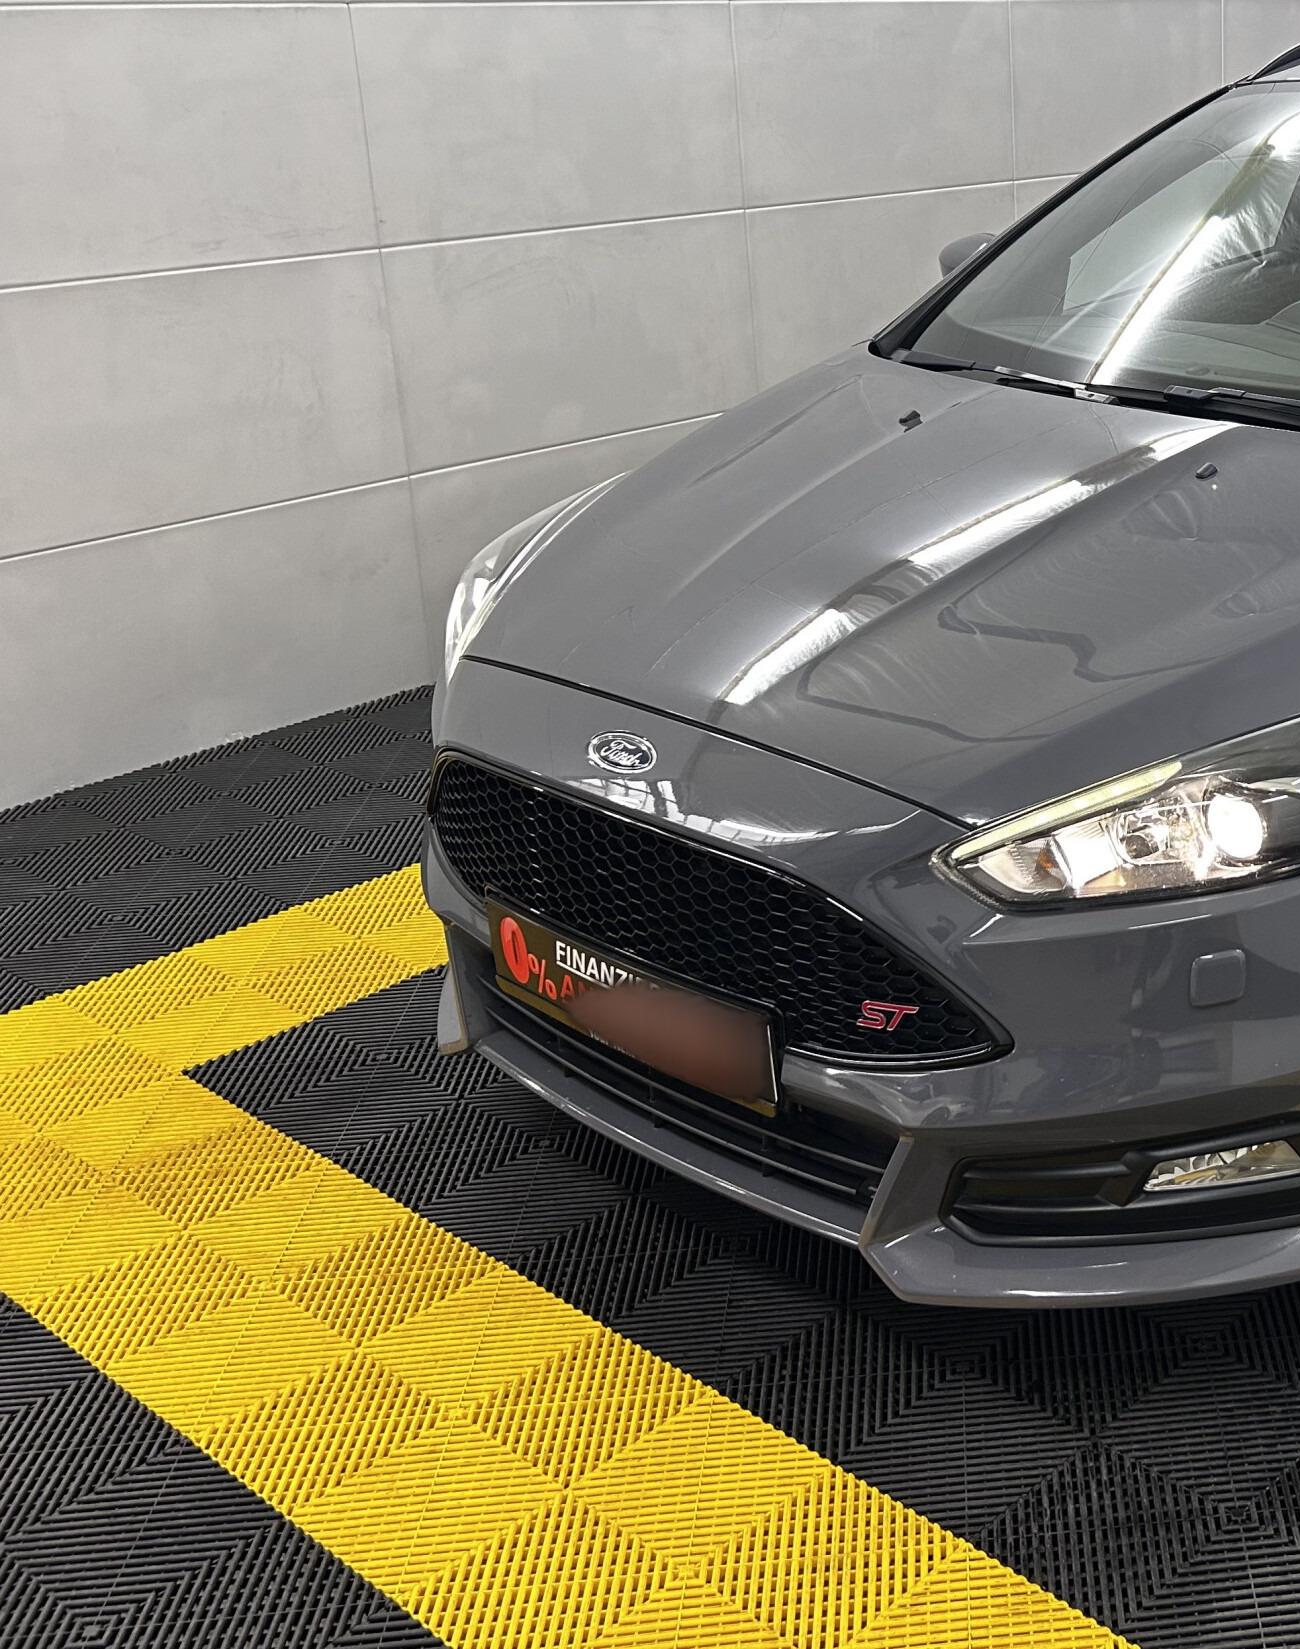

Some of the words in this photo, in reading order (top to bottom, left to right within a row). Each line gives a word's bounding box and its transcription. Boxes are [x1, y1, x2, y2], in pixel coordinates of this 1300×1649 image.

[600, 740, 648, 767] Ford
[500, 916, 557, 1000] 0%
[555, 940, 660, 989] FINANZI
[856, 1000, 920, 1031] ST
